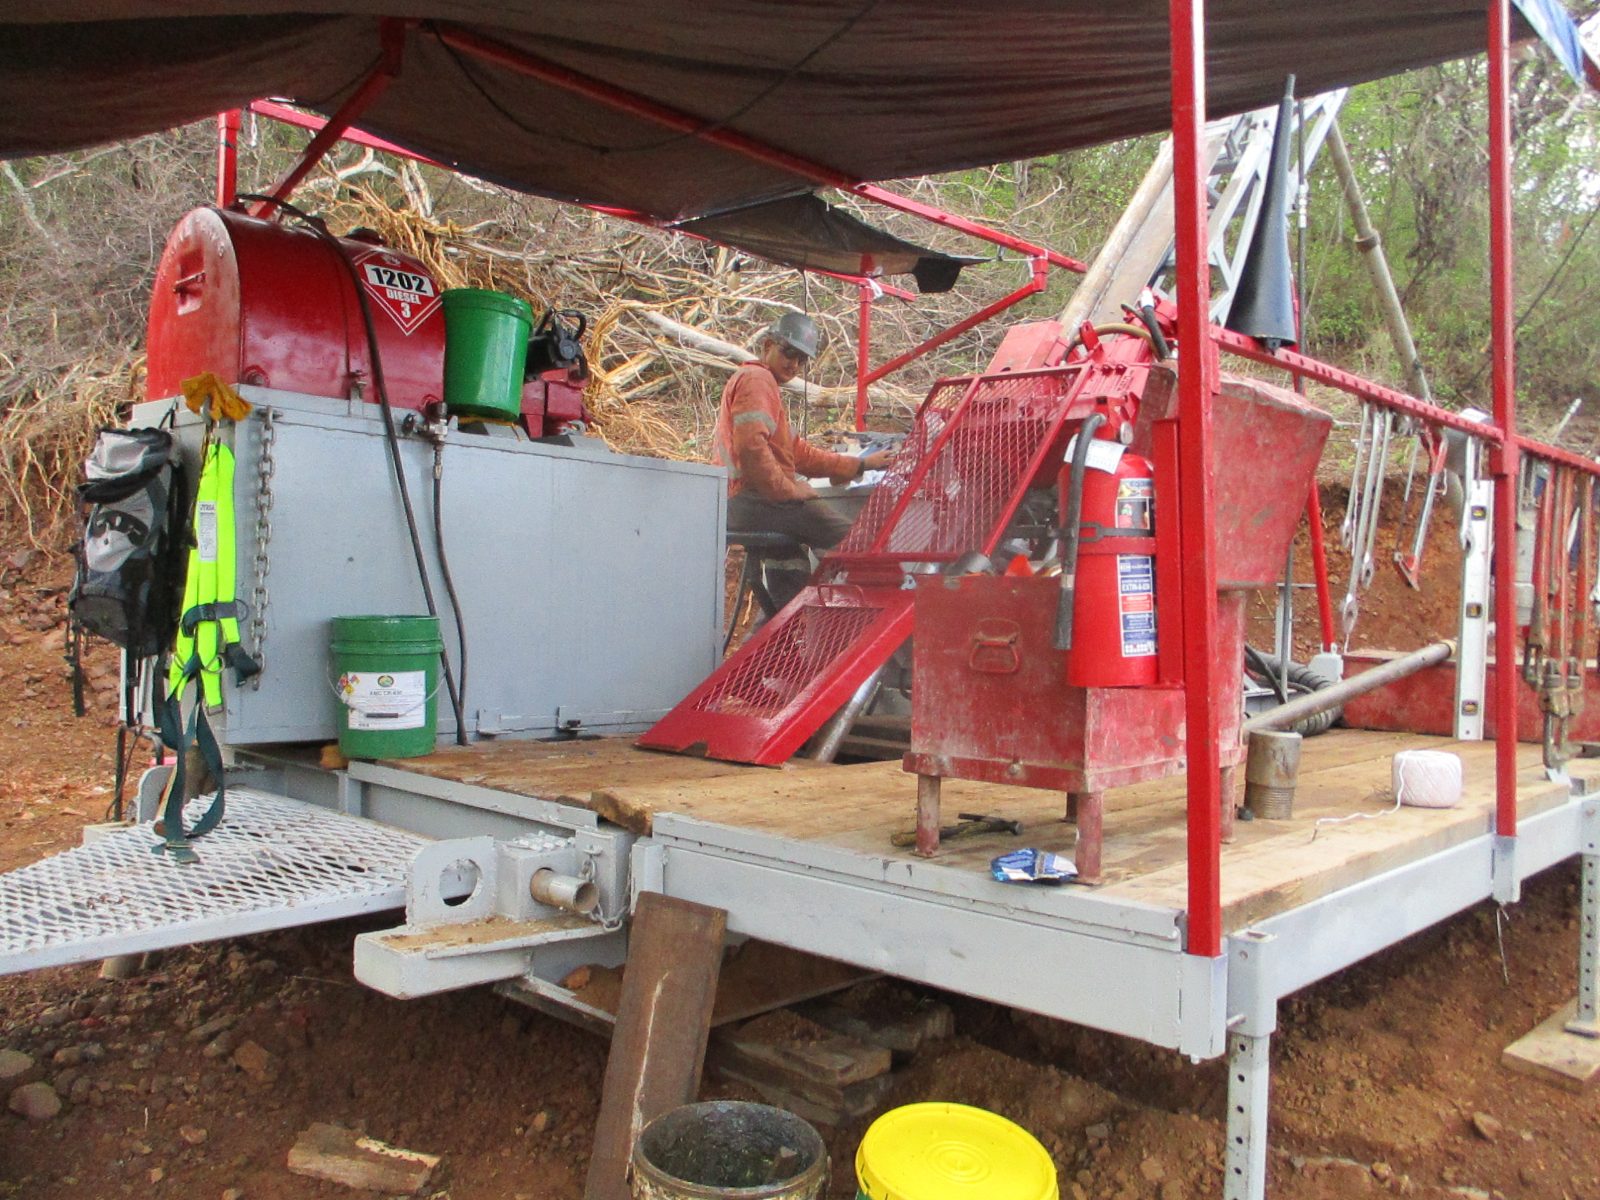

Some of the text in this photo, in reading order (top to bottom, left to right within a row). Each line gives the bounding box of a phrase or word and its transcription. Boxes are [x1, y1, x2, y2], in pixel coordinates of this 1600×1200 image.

[371, 267, 427, 294] 1202
[386, 288, 421, 304] DIESEL
[401, 302, 411, 318] 3
